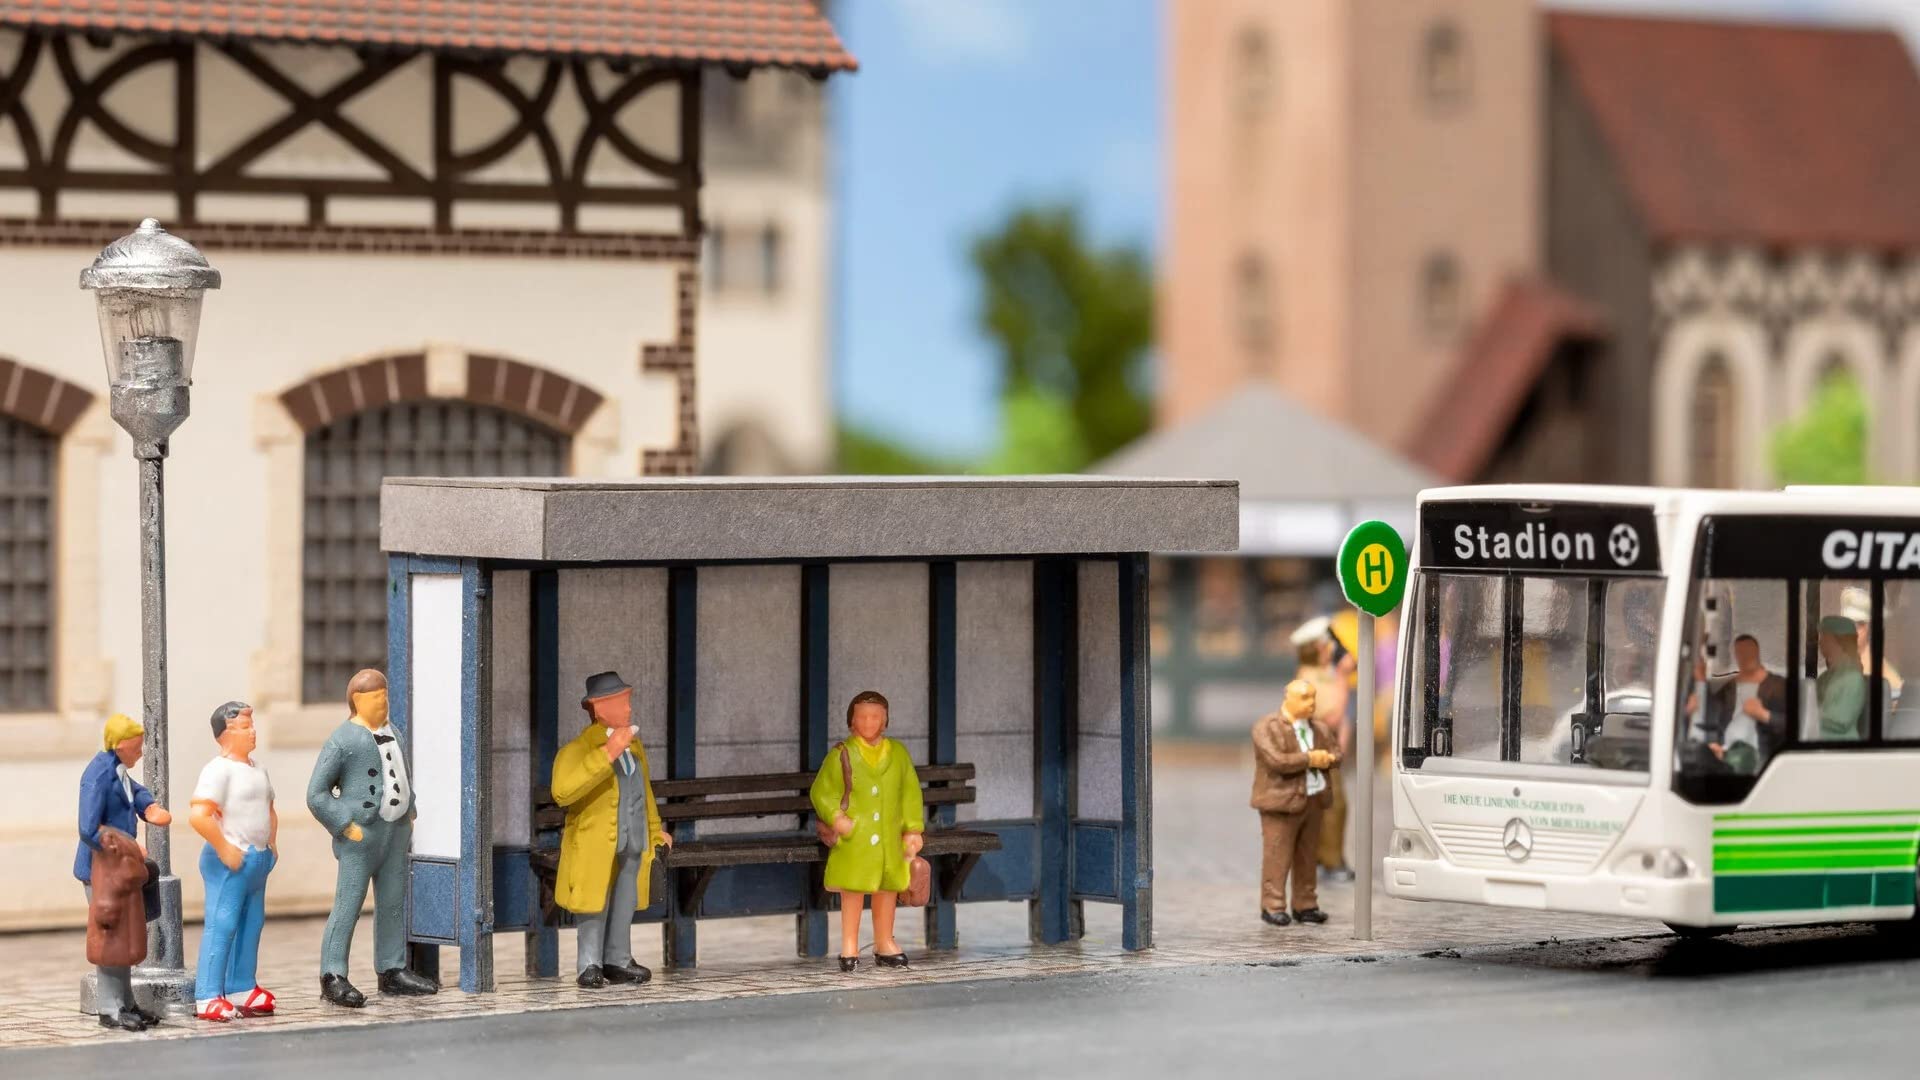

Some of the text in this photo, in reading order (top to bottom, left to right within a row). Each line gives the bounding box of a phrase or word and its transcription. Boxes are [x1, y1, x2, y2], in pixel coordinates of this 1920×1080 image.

[1454, 522, 1595, 560] Stadion
[1364, 550, 1387, 588] H
[1444, 793, 1457, 805] DIE
[1459, 794, 1482, 807] NEUE
[1529, 815, 1548, 827] VON
